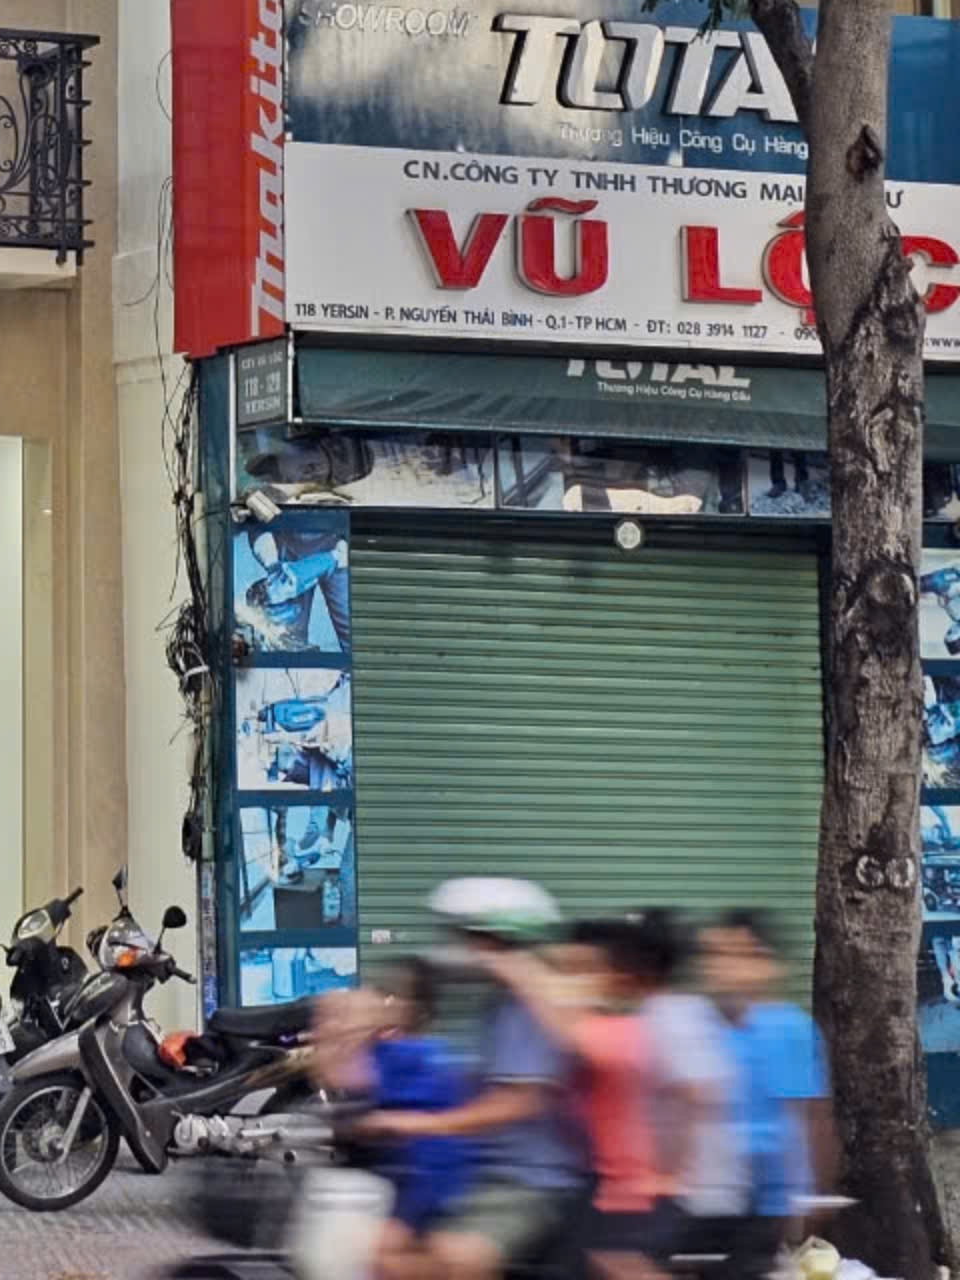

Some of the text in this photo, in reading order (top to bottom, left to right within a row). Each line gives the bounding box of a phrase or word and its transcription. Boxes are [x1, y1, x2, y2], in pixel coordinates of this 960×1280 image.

[491, 12, 802, 124] TOTA
[632, 127, 670, 151] Hiệu
[679, 130, 722, 153] Công
[732, 133, 755, 158] Cụ
[765, 135, 808, 160] Hàng
[403, 158, 519, 186] CN.CÔNG
[528, 168, 558, 188] TY
[571, 170, 636, 193] TNHH
[647, 175, 748, 200] THƯƠNG
[759, 183, 804, 206] MẠI
[406, 196, 609, 297] VŨ
[295, 303, 316, 317] 118
[321, 303, 369, 320] YERSIN
[385, 306, 396, 321] P.
[463, 307, 495, 326] THÁI
[501, 309, 533, 327] BÌNH
[677, 321, 701, 335] 028
[707, 322, 734, 337] 3914
[741, 324, 768, 339] 1127
